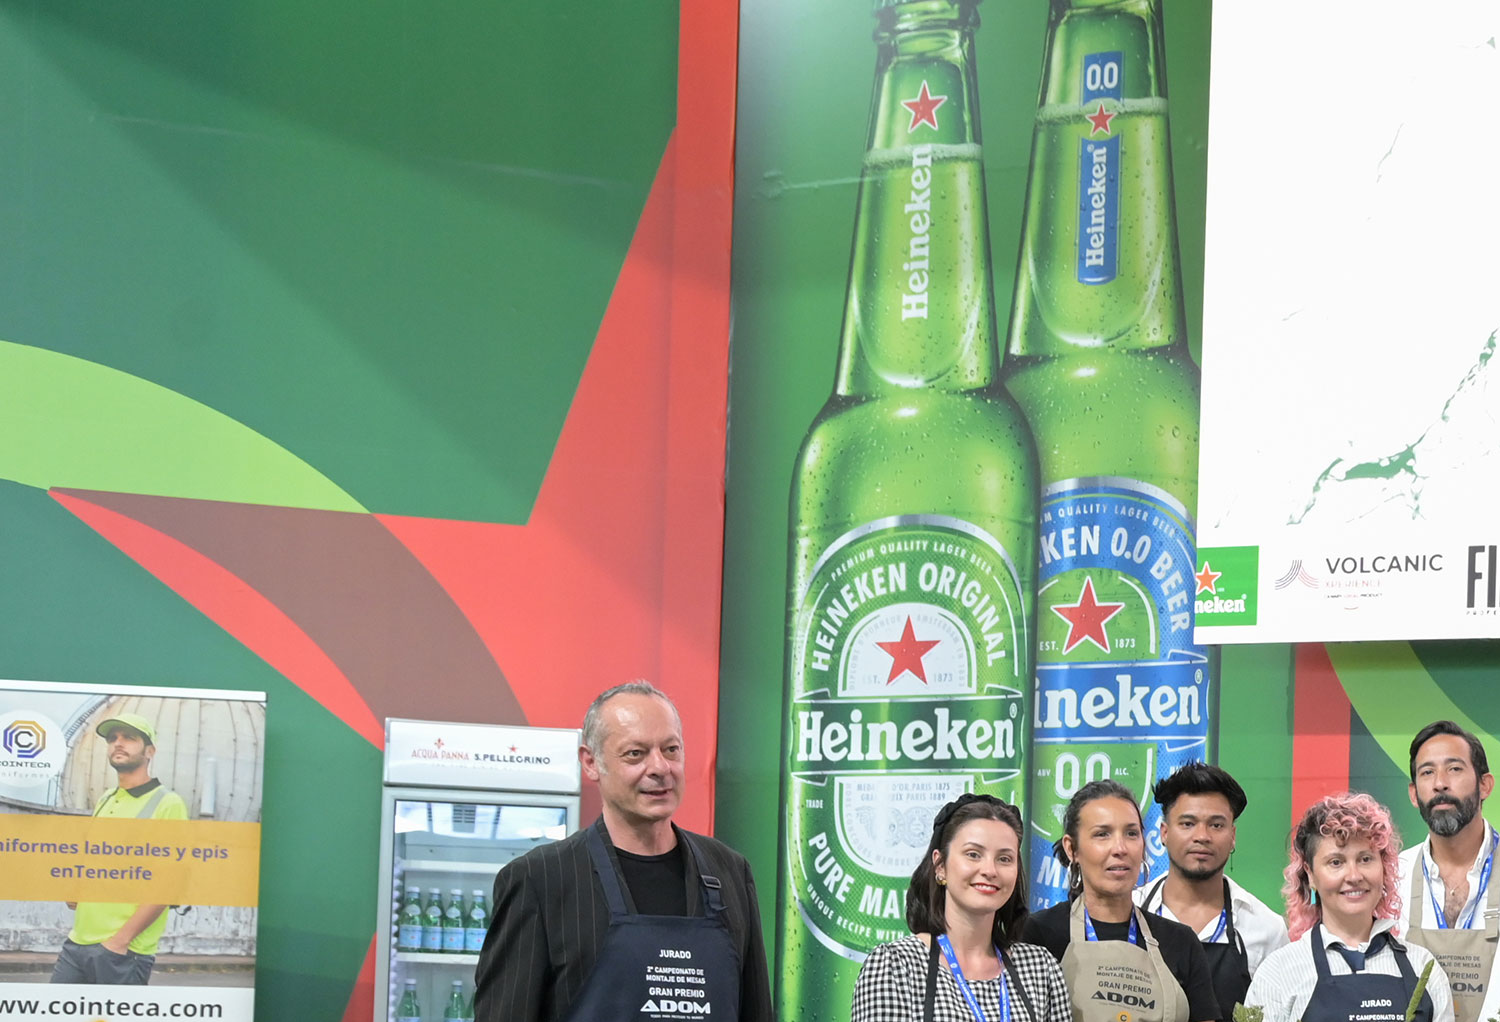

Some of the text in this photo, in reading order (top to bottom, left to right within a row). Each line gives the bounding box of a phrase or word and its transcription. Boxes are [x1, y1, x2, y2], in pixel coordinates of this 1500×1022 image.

[1085, 147, 1108, 267] Heineken
[902, 145, 932, 322] Heineken
[1058, 504, 1107, 518] QUALITY
[1114, 505, 1149, 522] LAGER
[1152, 517, 1176, 538] BEER
[831, 540, 993, 581] PREMIUM QUALITY LAGER BEER
[1325, 553, 1444, 576] VOLCANIC
[1111, 527, 1151, 564] 0.0
[1150, 550, 1190, 633] BEER
[1194, 596, 1245, 613] neken
[811, 562, 907, 672] HEINEKEN
[919, 562, 1006, 667] ORIGINAL
[1039, 638, 1136, 650] EST. 1873
[934, 673, 953, 683] 1873
[797, 708, 1015, 762] Heineken
[1115, 768, 1129, 776] ALC.
[935, 782, 950, 790] 1875
[806, 799, 823, 809] TRADE
[85, 840, 170, 857] laborales
[176, 847, 186, 861] y
[192, 845, 229, 864] epis
[51, 864, 152, 881] enTenerife
[808, 832, 854, 903] PURE
[806, 883, 904, 941] UNIQUE RECIPE WITH
[659, 949, 691, 959] JURADO
[646, 975, 675, 983] MONTAJE
[654, 966, 696, 975] CAMPEONATO
[1105, 966, 1143, 976] CAMPEONATO
[1451, 972, 1479, 980] PREMIO
[649, 987, 705, 998] GRAN PREMIO
[1098, 981, 1151, 995] GRAN PREMIO
[0, 997, 223, 1018] ww.cointeca.com
[640, 999, 711, 1014] ADOM
[1091, 990, 1155, 1010] ADOM
[1360, 1000, 1392, 1008] JURADO
